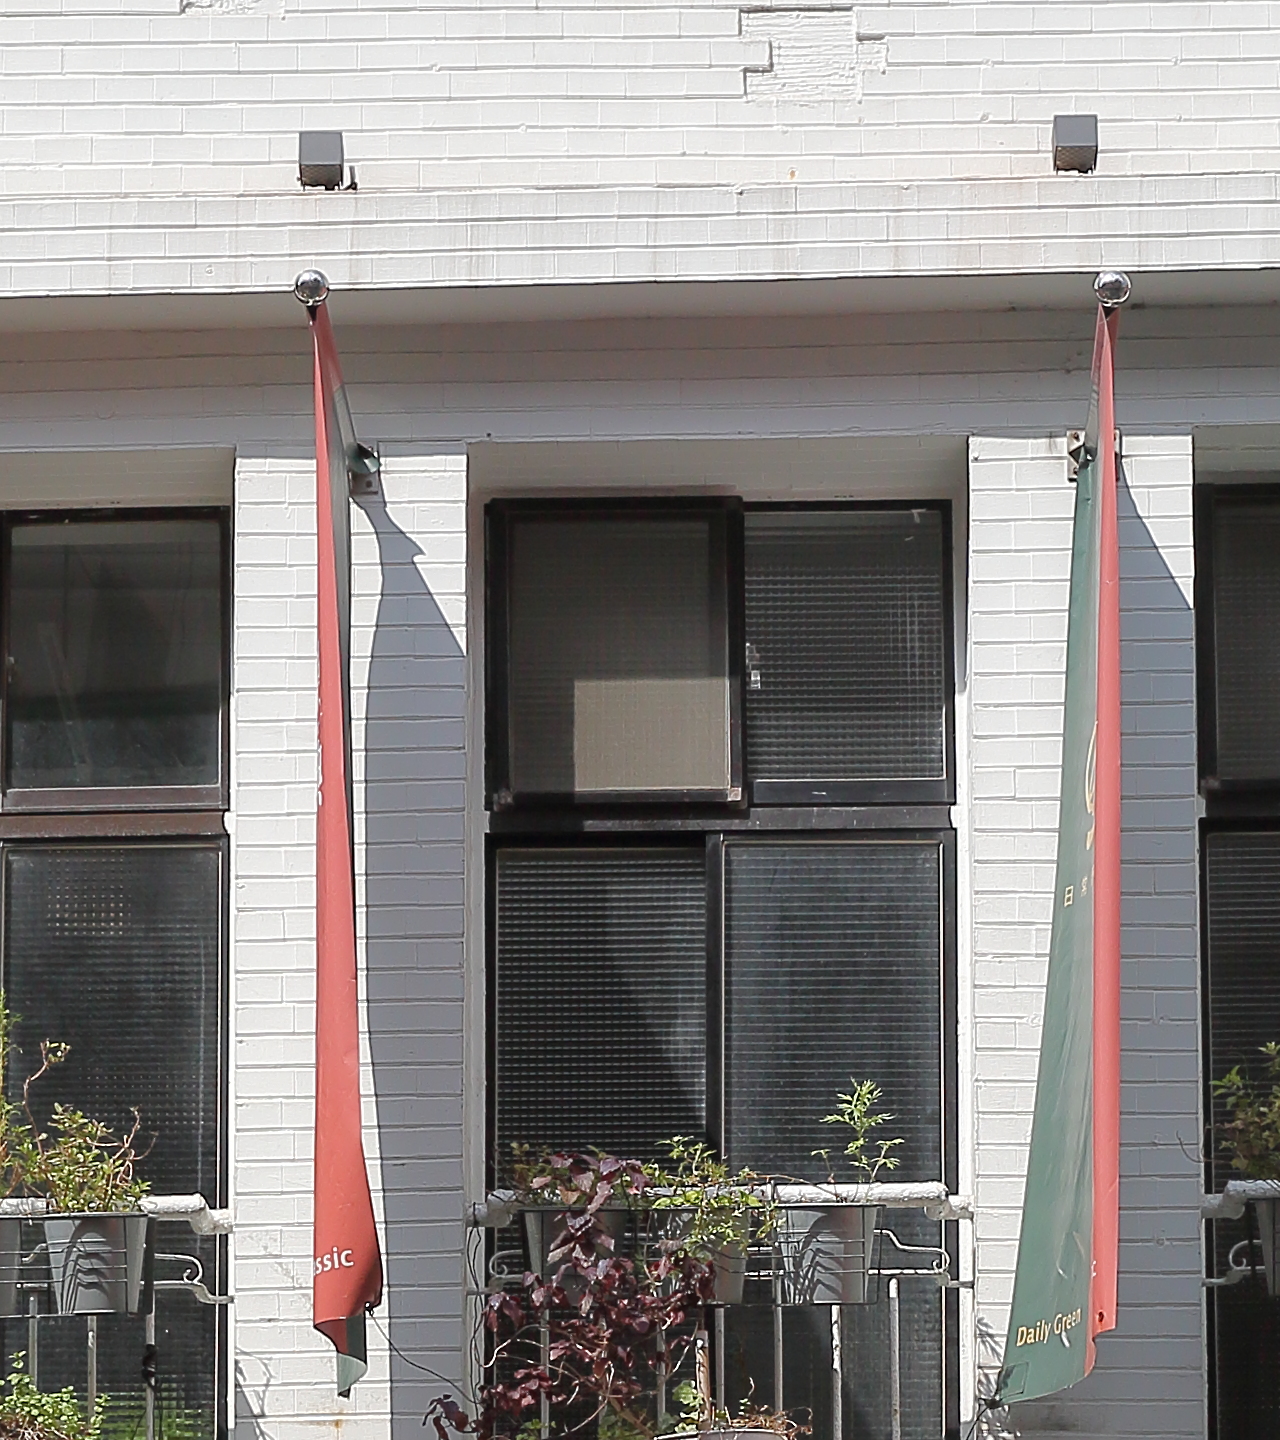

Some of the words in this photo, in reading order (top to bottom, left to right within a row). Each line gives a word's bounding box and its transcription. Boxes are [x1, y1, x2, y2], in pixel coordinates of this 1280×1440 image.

[313, 1246, 355, 1276] ssic
[1016, 1319, 1052, 1347] Daily
[1053, 1308, 1081, 1335] Green
